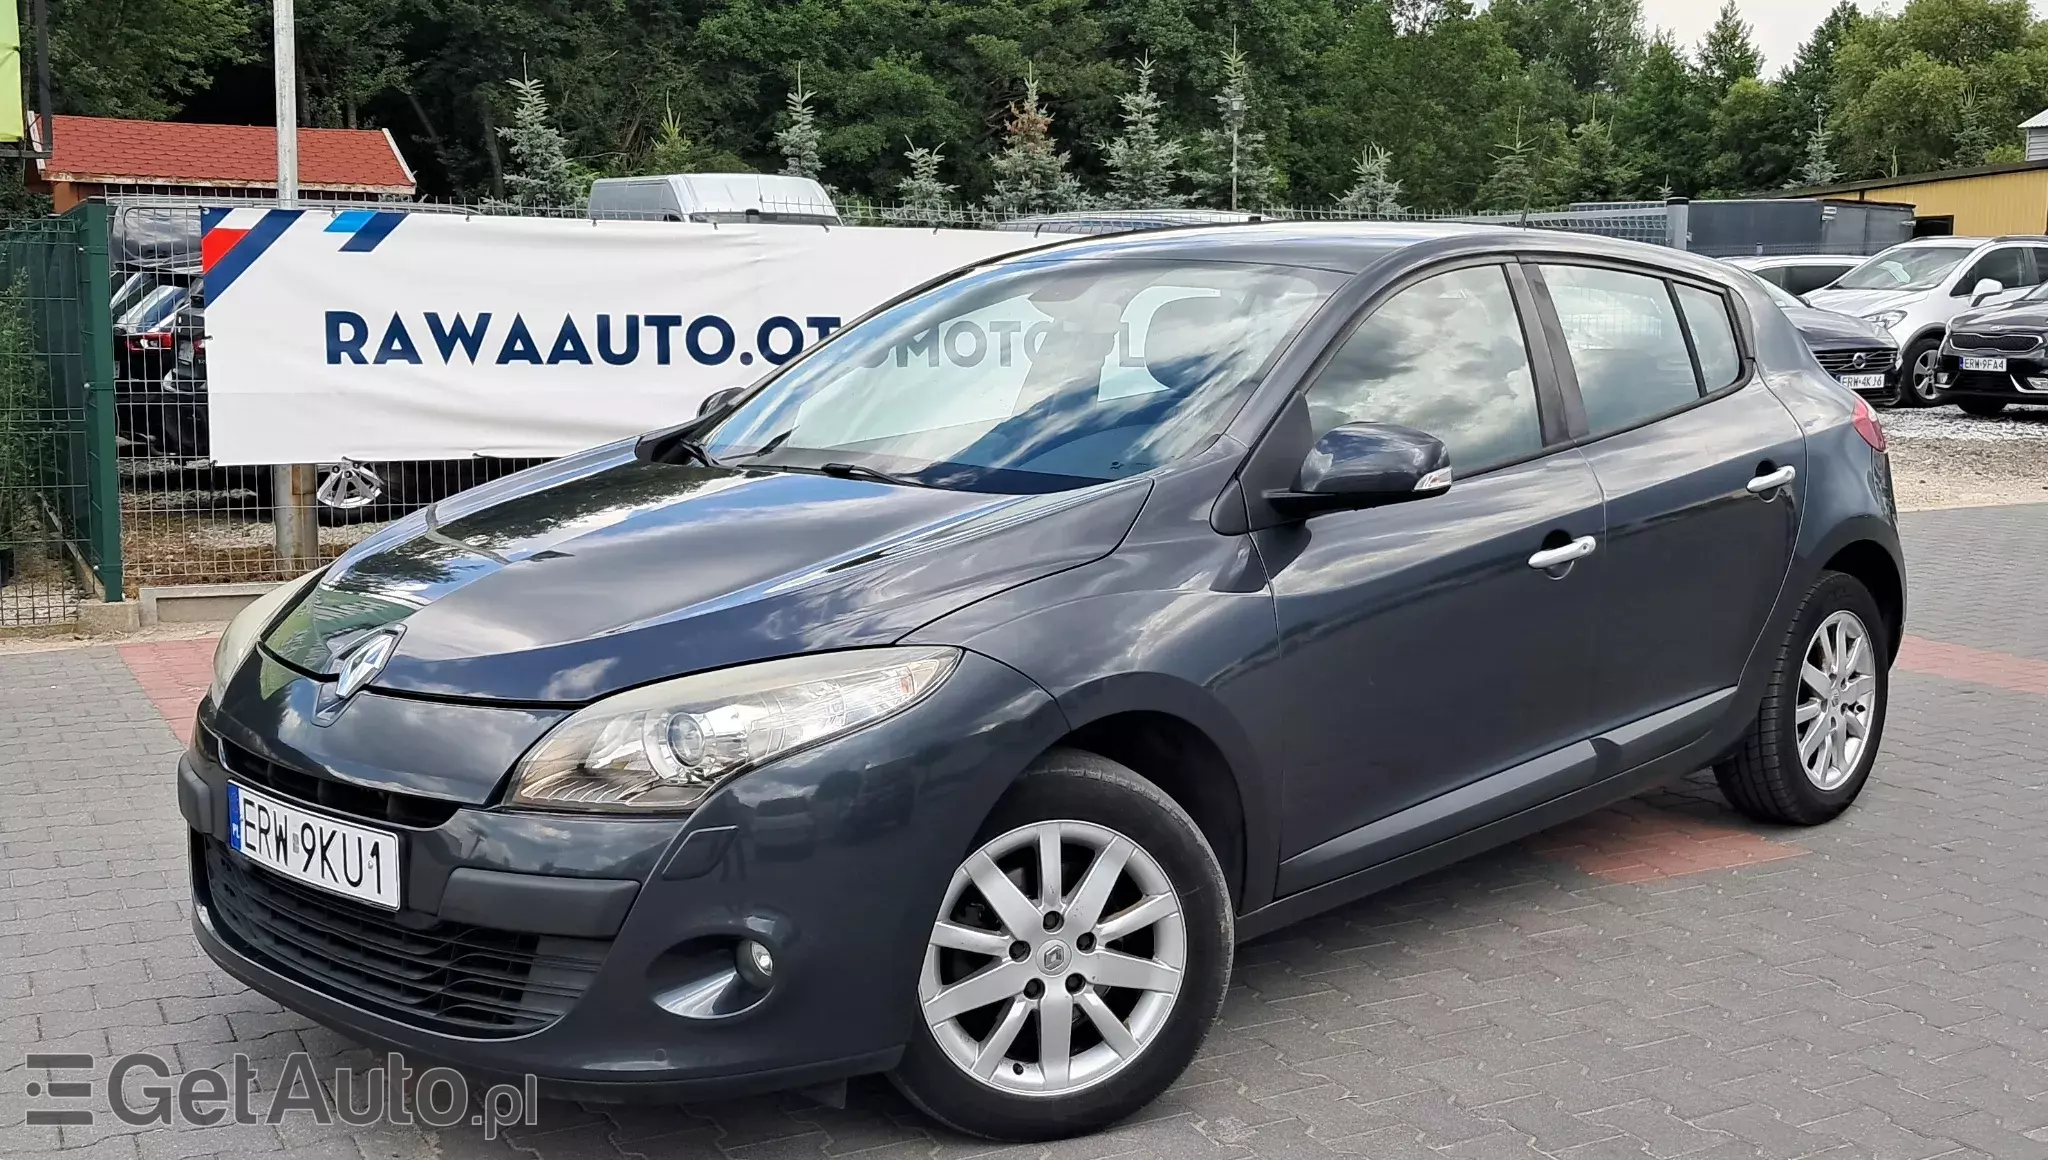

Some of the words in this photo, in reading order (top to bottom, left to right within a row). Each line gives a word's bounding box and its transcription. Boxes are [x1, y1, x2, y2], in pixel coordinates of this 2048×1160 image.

[1964, 358, 1980, 369] ERW
[1982, 359, 2004, 370] 9FA4
[1842, 376, 1859, 387] ERW
[242, 798, 289, 867] ERW
[300, 822, 382, 895] 9KU1
